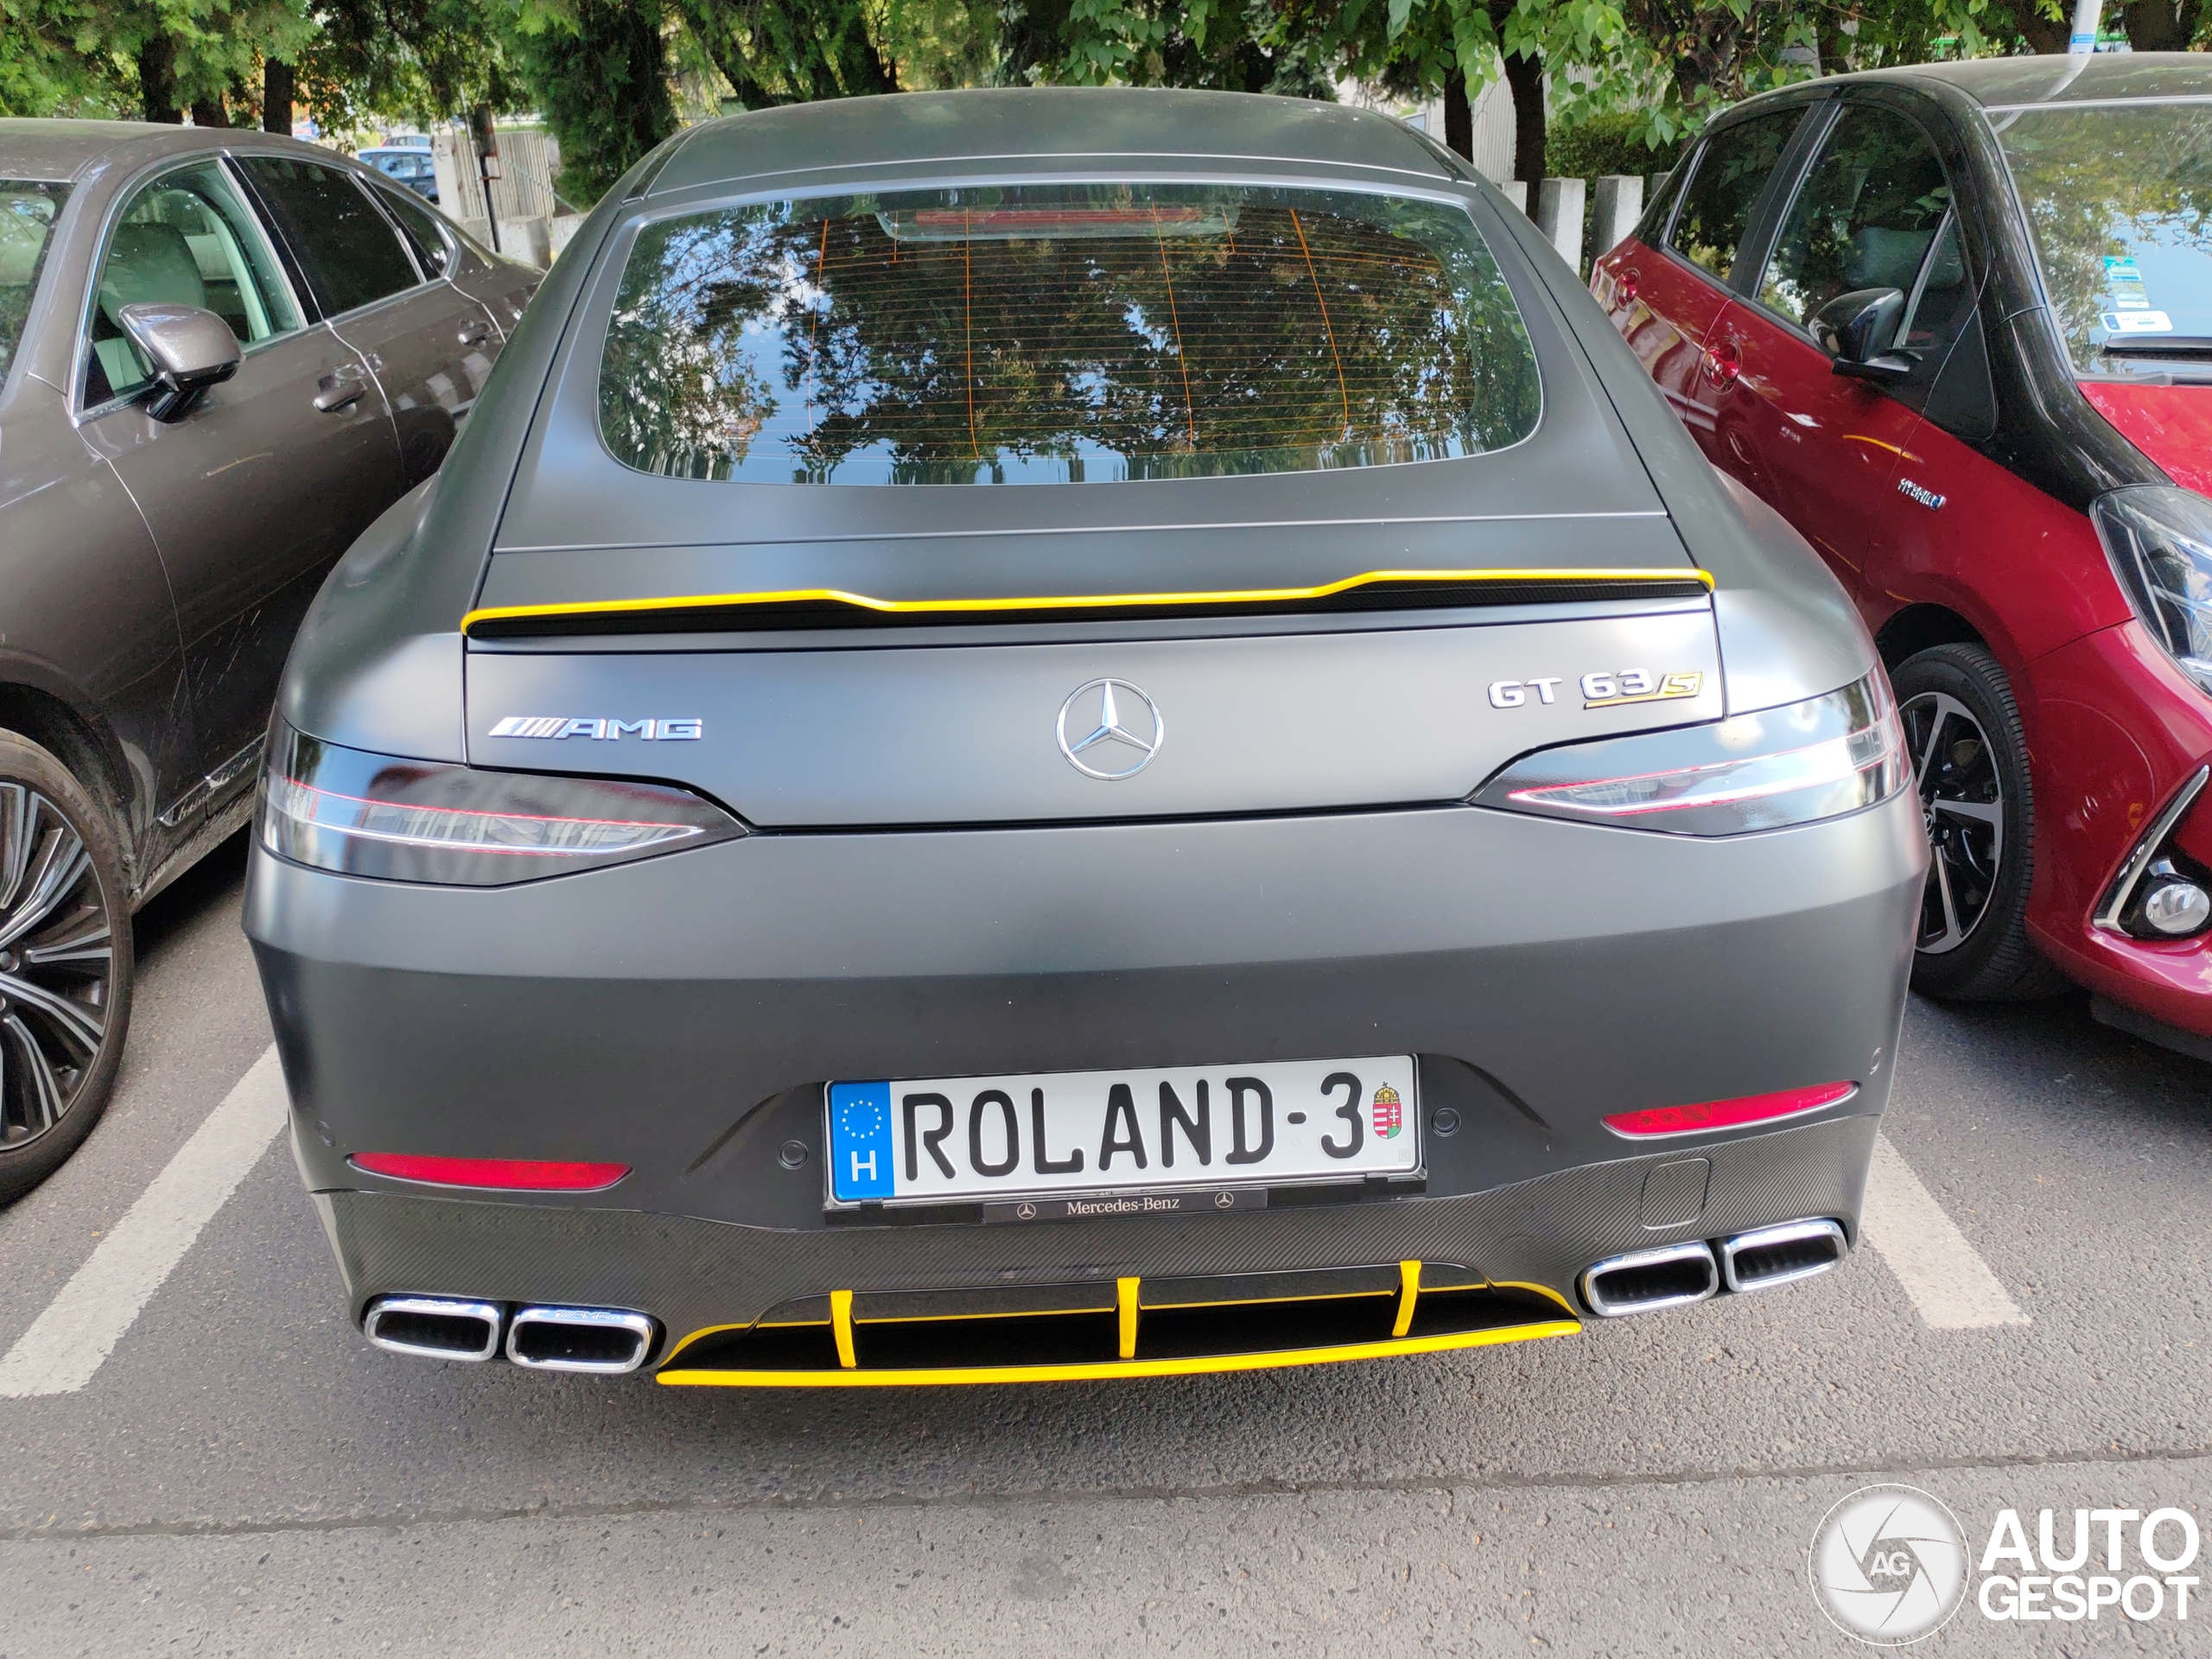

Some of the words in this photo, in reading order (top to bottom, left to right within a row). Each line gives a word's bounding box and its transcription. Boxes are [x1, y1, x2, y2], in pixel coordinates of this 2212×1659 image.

[1488, 677, 1563, 709] GT
[554, 718, 702, 741] AMG
[902, 1071, 1365, 1182] ROLAND-3
[850, 1149, 877, 1182] H
[1066, 1197, 1180, 1215] Mercedes-Benz
